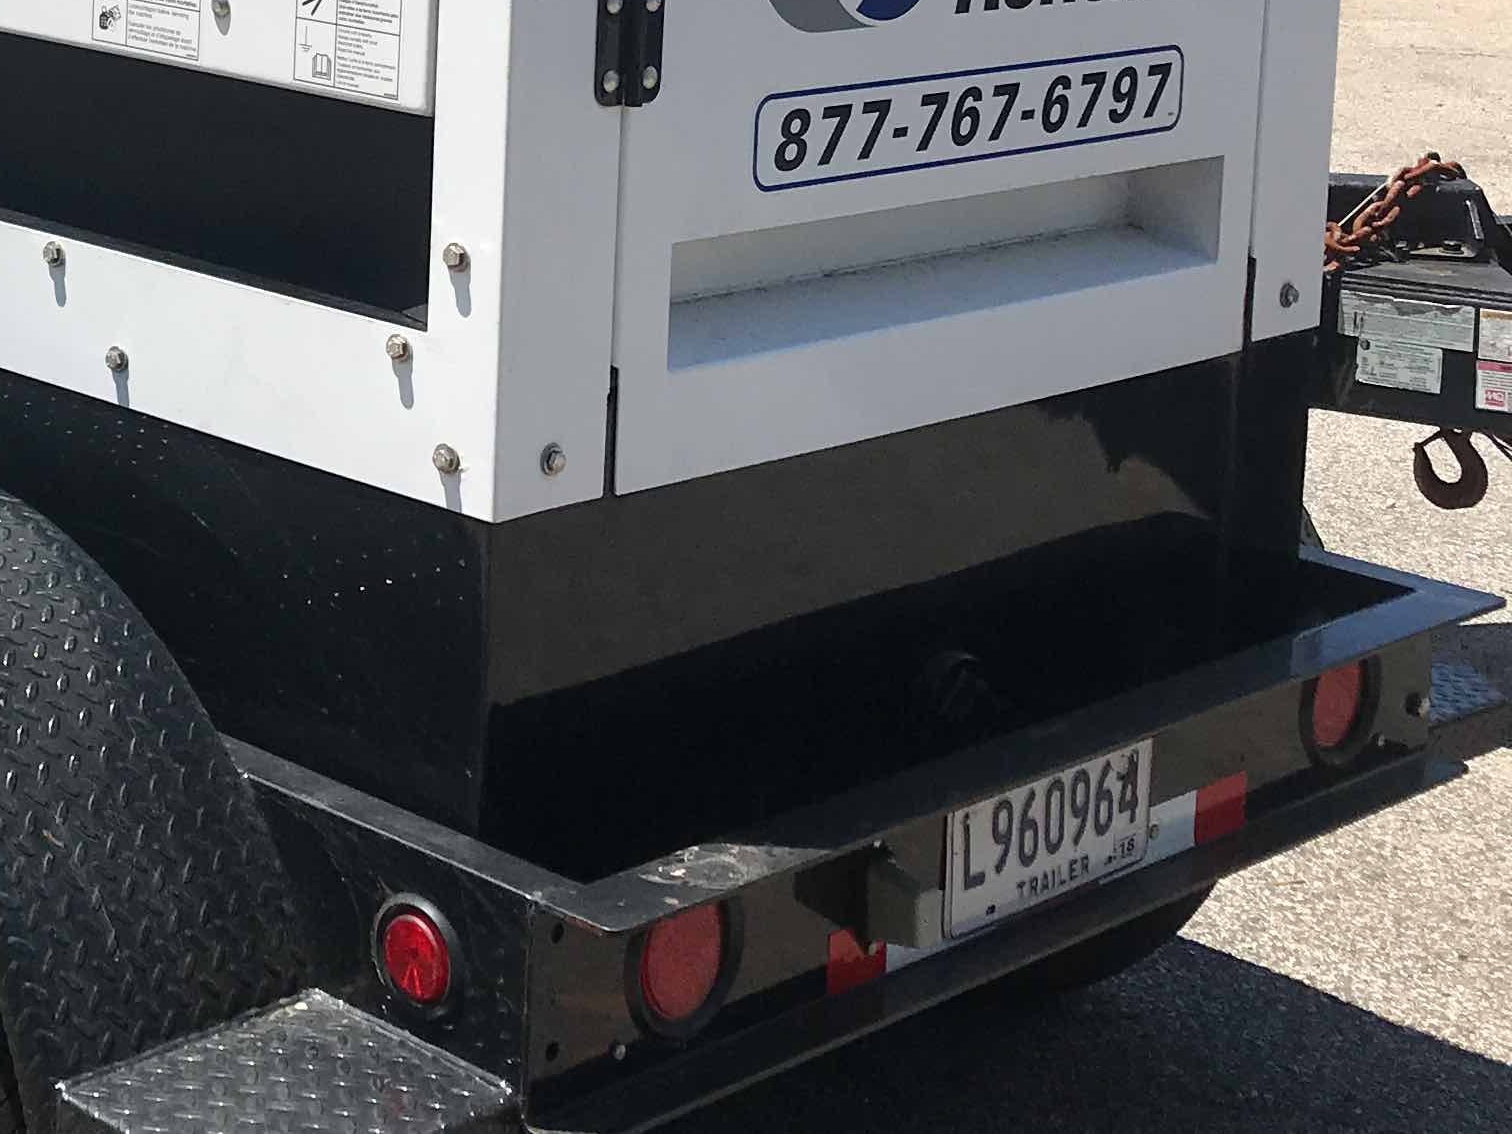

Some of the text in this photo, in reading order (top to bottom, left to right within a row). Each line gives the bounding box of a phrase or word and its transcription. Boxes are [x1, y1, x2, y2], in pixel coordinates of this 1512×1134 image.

[773, 61, 1174, 172] 877-767-6797
[962, 749, 1140, 891] L960964
[1015, 855, 1091, 899] TRAILER
